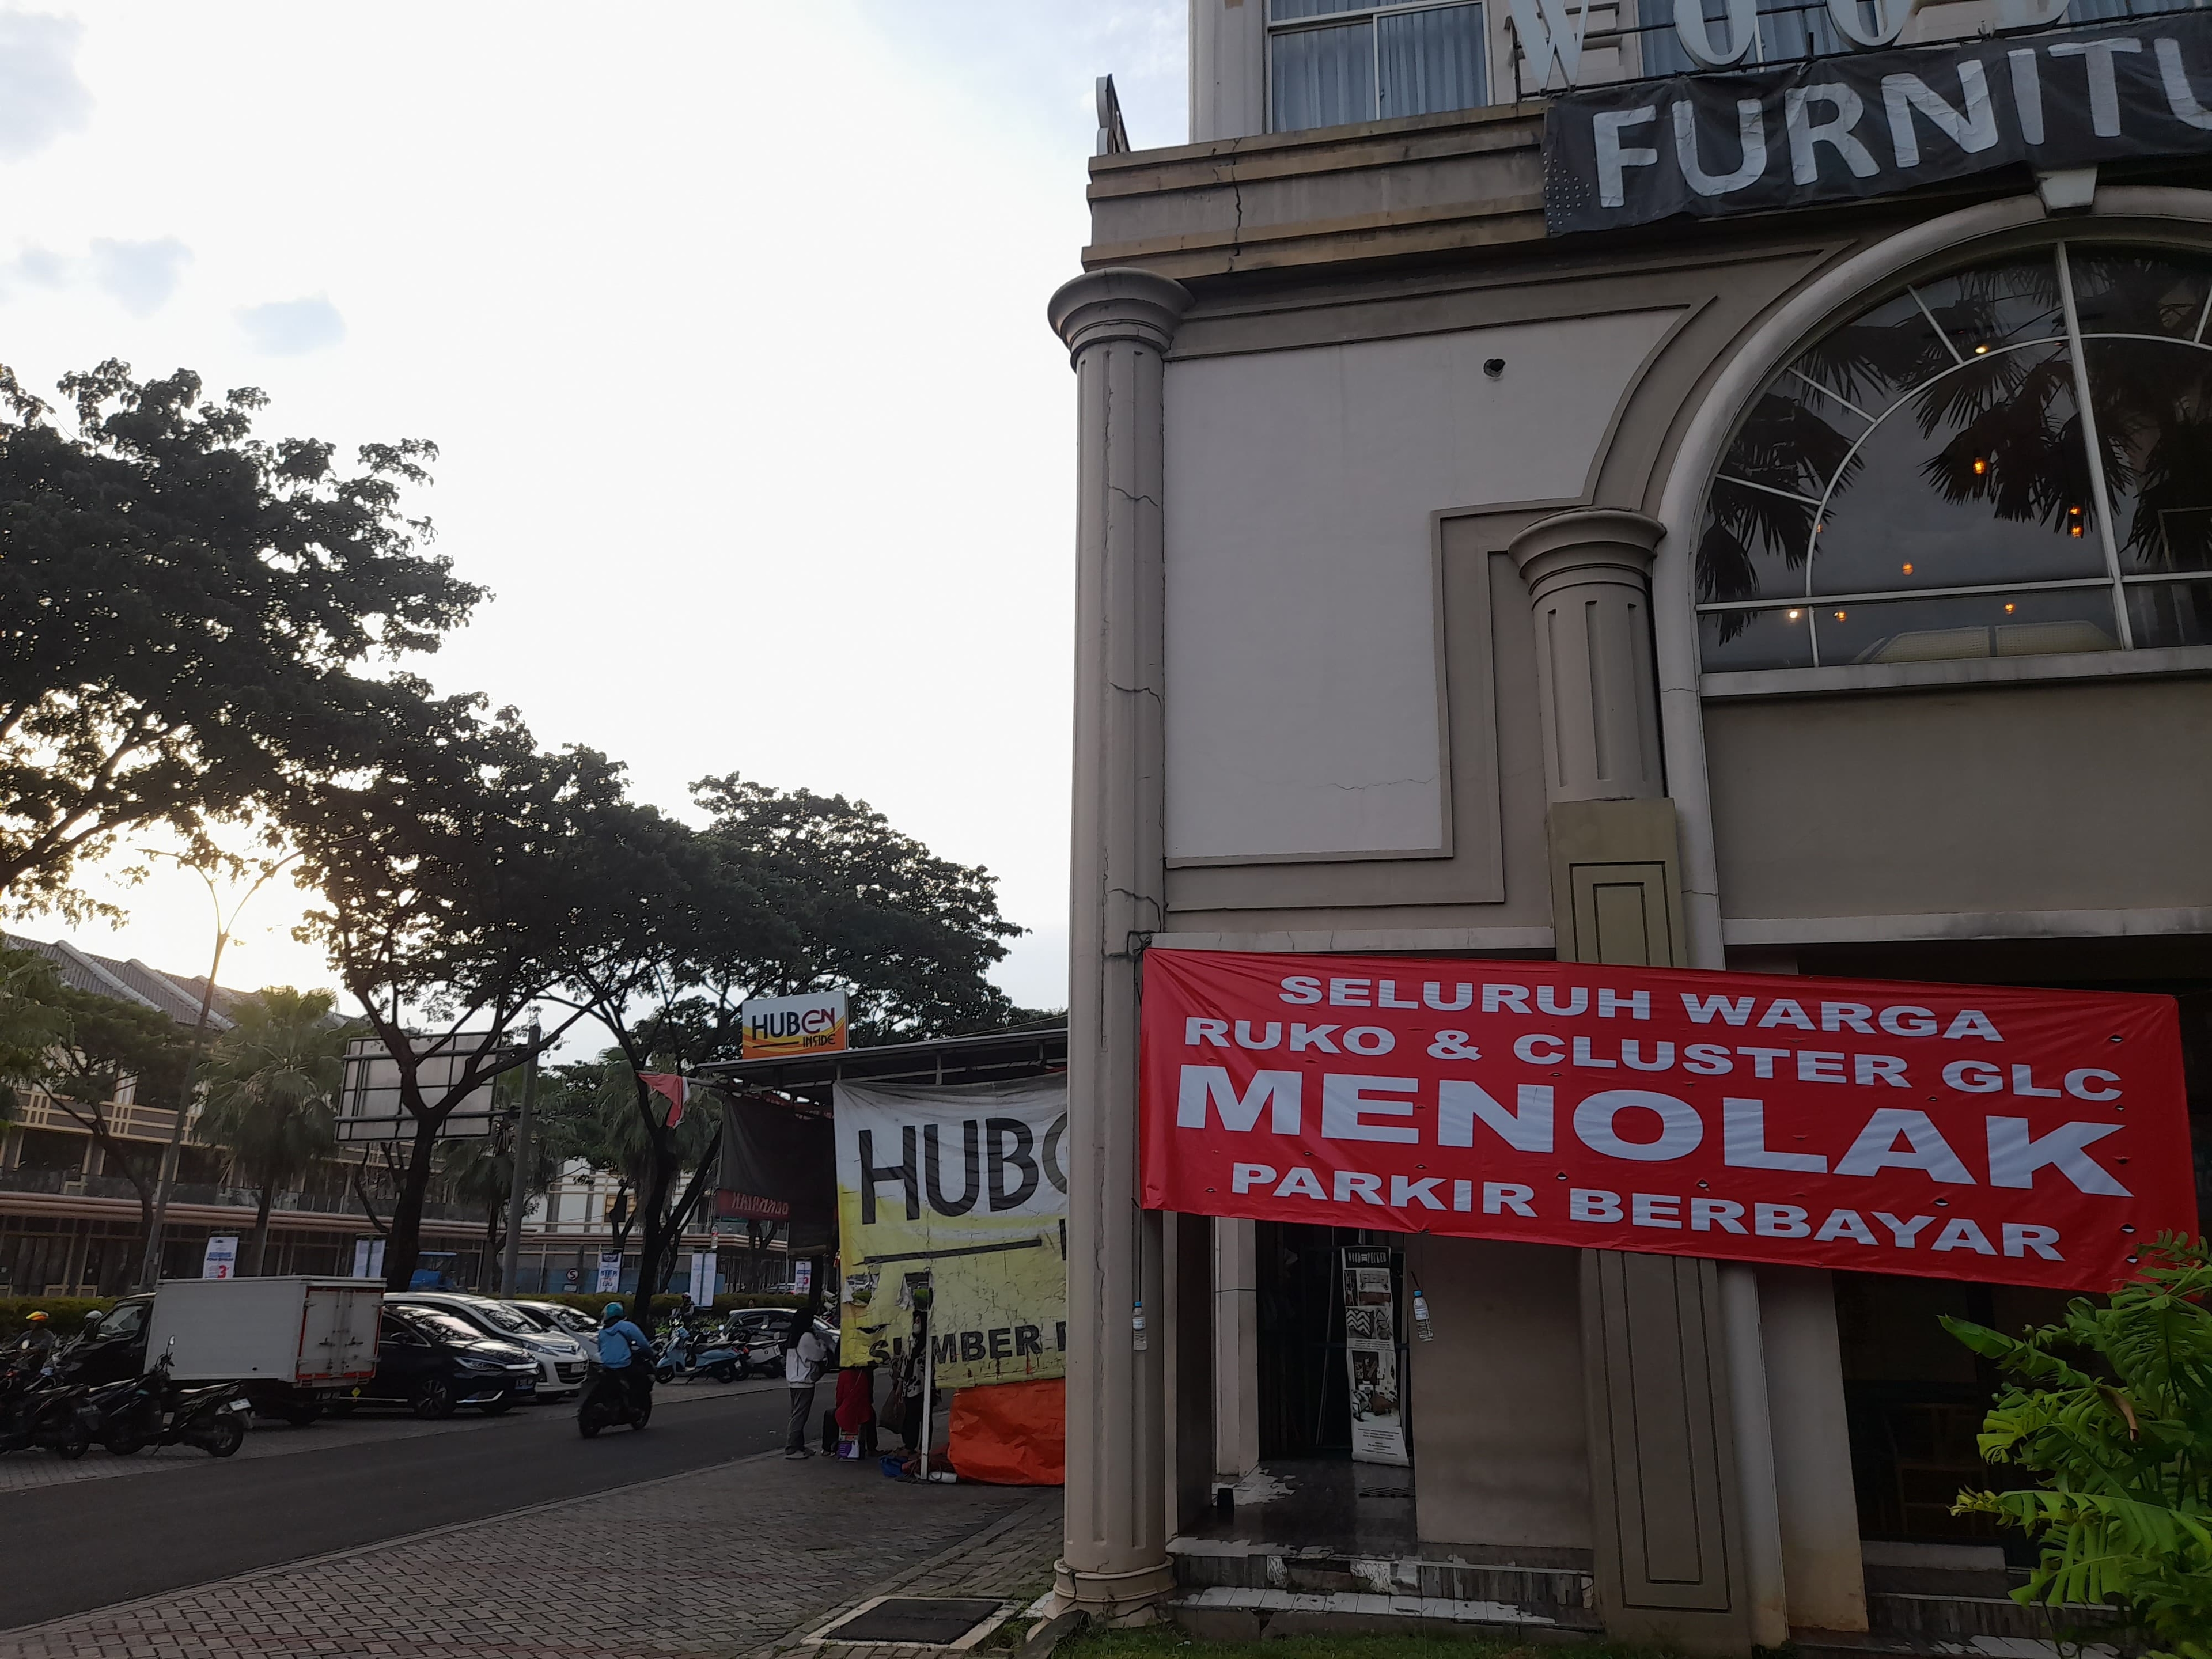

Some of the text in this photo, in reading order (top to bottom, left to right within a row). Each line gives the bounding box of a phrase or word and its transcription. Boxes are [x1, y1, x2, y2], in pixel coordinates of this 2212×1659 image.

[802, 1033, 836, 1048] INSIDE
[1278, 975, 2005, 1042] SELURUH WARGA
[1185, 1016, 2123, 1101] RUKO & CLUSTER GLC
[1176, 1064, 2135, 1198] MENOLAK
[1232, 1162, 2066, 1262] PARKIR BERBAYAR
